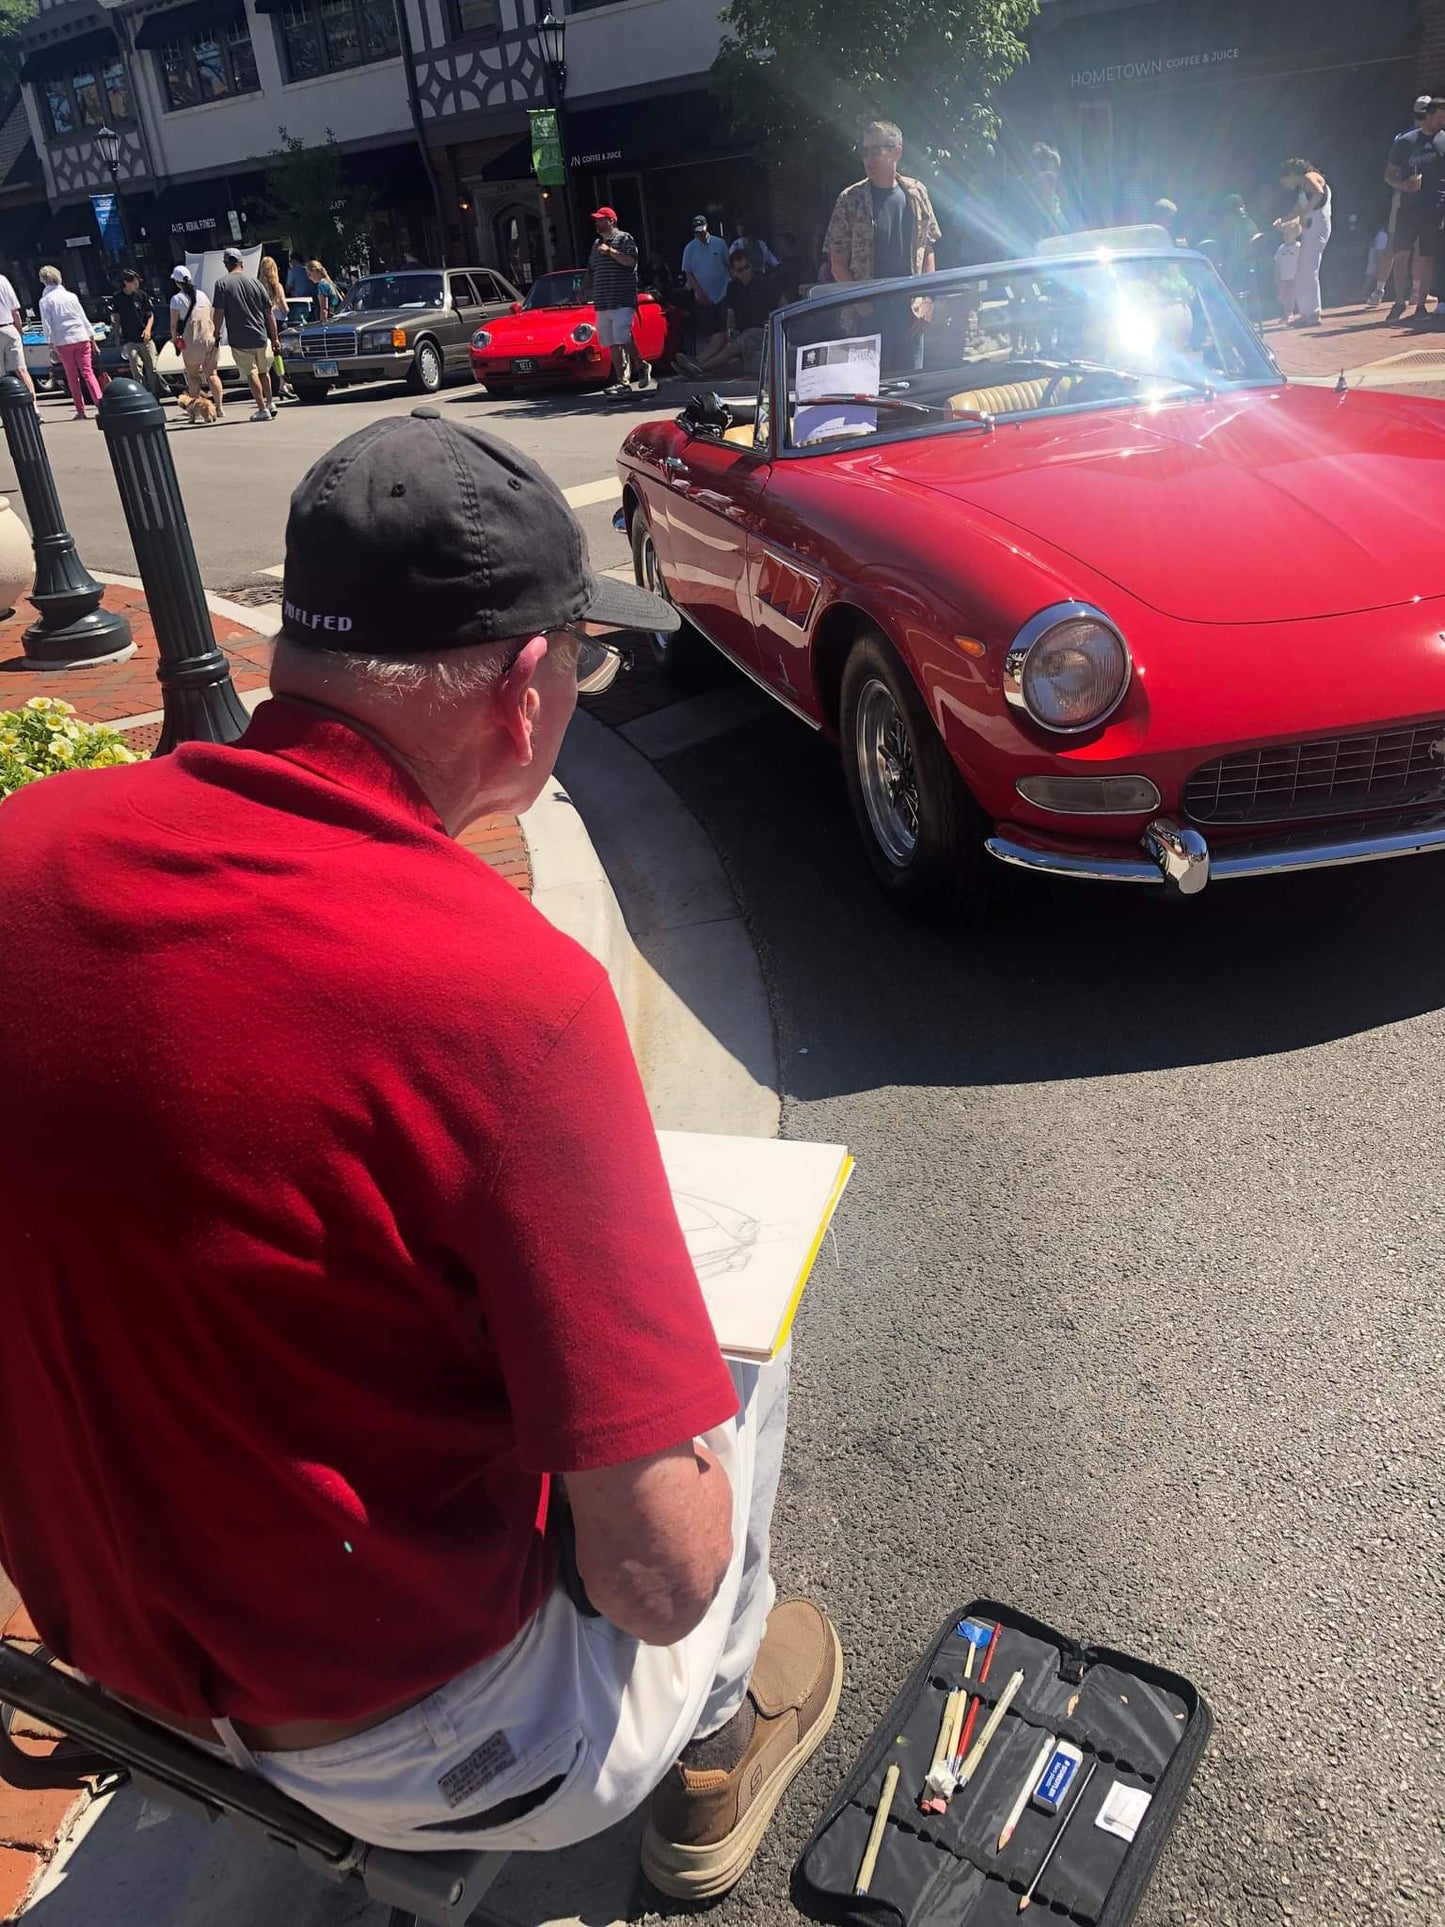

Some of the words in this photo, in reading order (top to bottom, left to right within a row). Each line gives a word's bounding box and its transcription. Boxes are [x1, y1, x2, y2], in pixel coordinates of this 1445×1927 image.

[1071, 58, 1162, 88] HOMETOWN
[1166, 54, 1201, 69] COFFEE
[1202, 53, 1209, 63] &
[1211, 48, 1239, 62] JUICE
